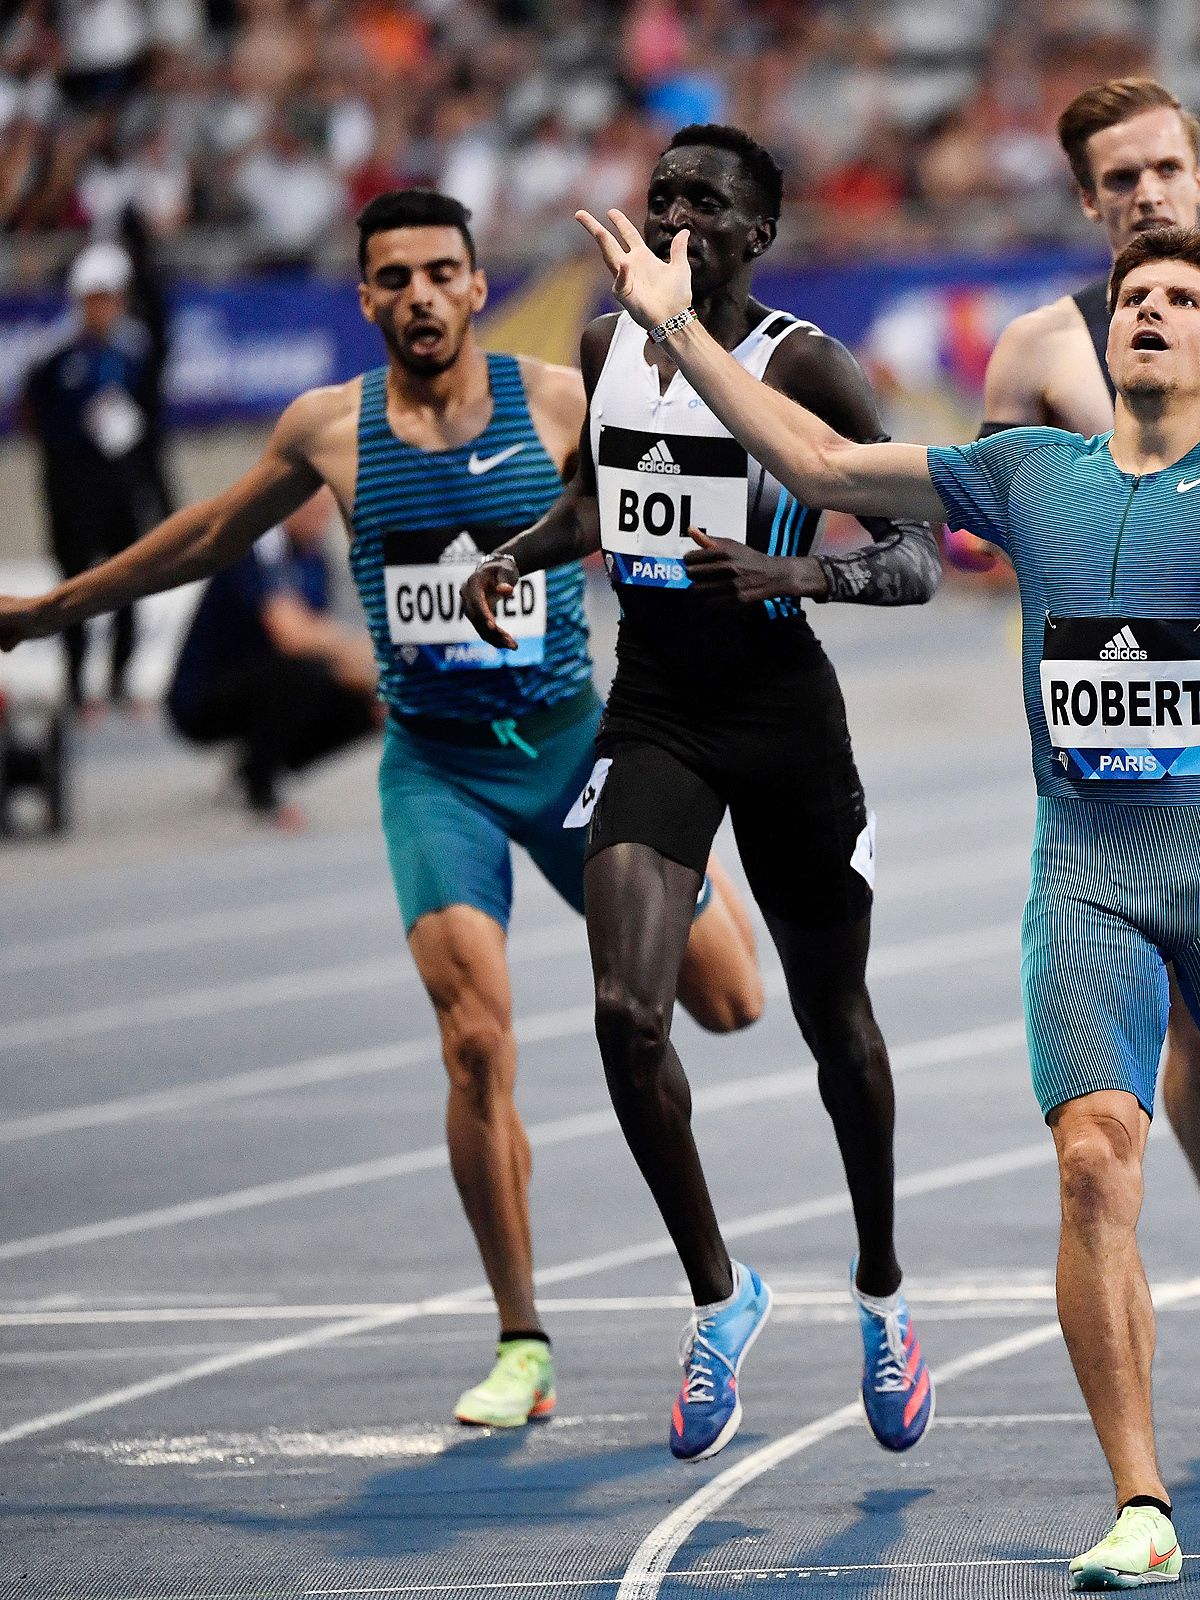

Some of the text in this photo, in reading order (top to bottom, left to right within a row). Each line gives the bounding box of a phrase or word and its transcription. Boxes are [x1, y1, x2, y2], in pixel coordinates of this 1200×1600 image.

[637, 460, 681, 474] adidas
[618, 488, 707, 537] BOL
[632, 561, 684, 581] PARIS
[396, 579, 535, 624] GOUED
[1099, 648, 1148, 661] adidas
[1100, 755, 1157, 772] PARIS
